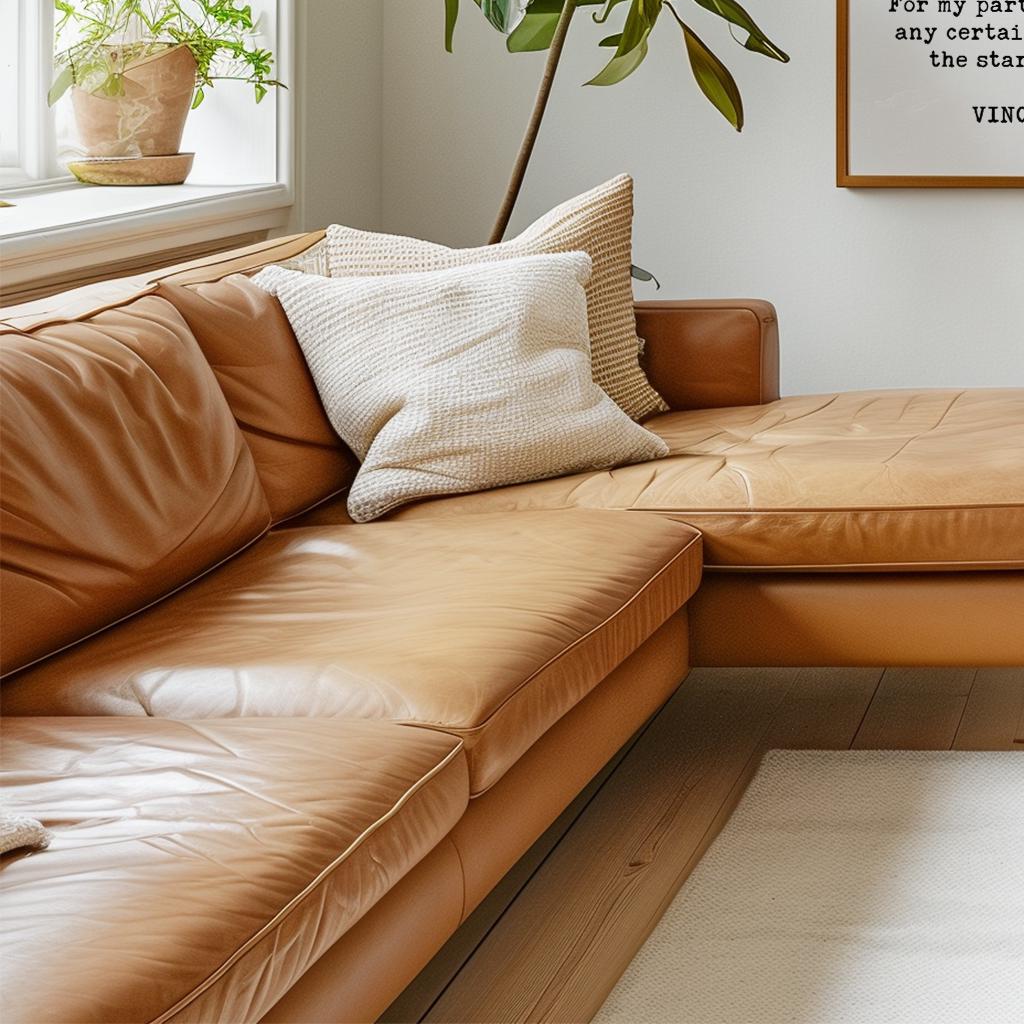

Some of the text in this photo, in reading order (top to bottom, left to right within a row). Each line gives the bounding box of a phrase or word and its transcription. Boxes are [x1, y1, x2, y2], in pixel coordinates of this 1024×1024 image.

[937, 0, 967, 18] my
[894, 26, 938, 45] any
[929, 50, 968, 68] the
